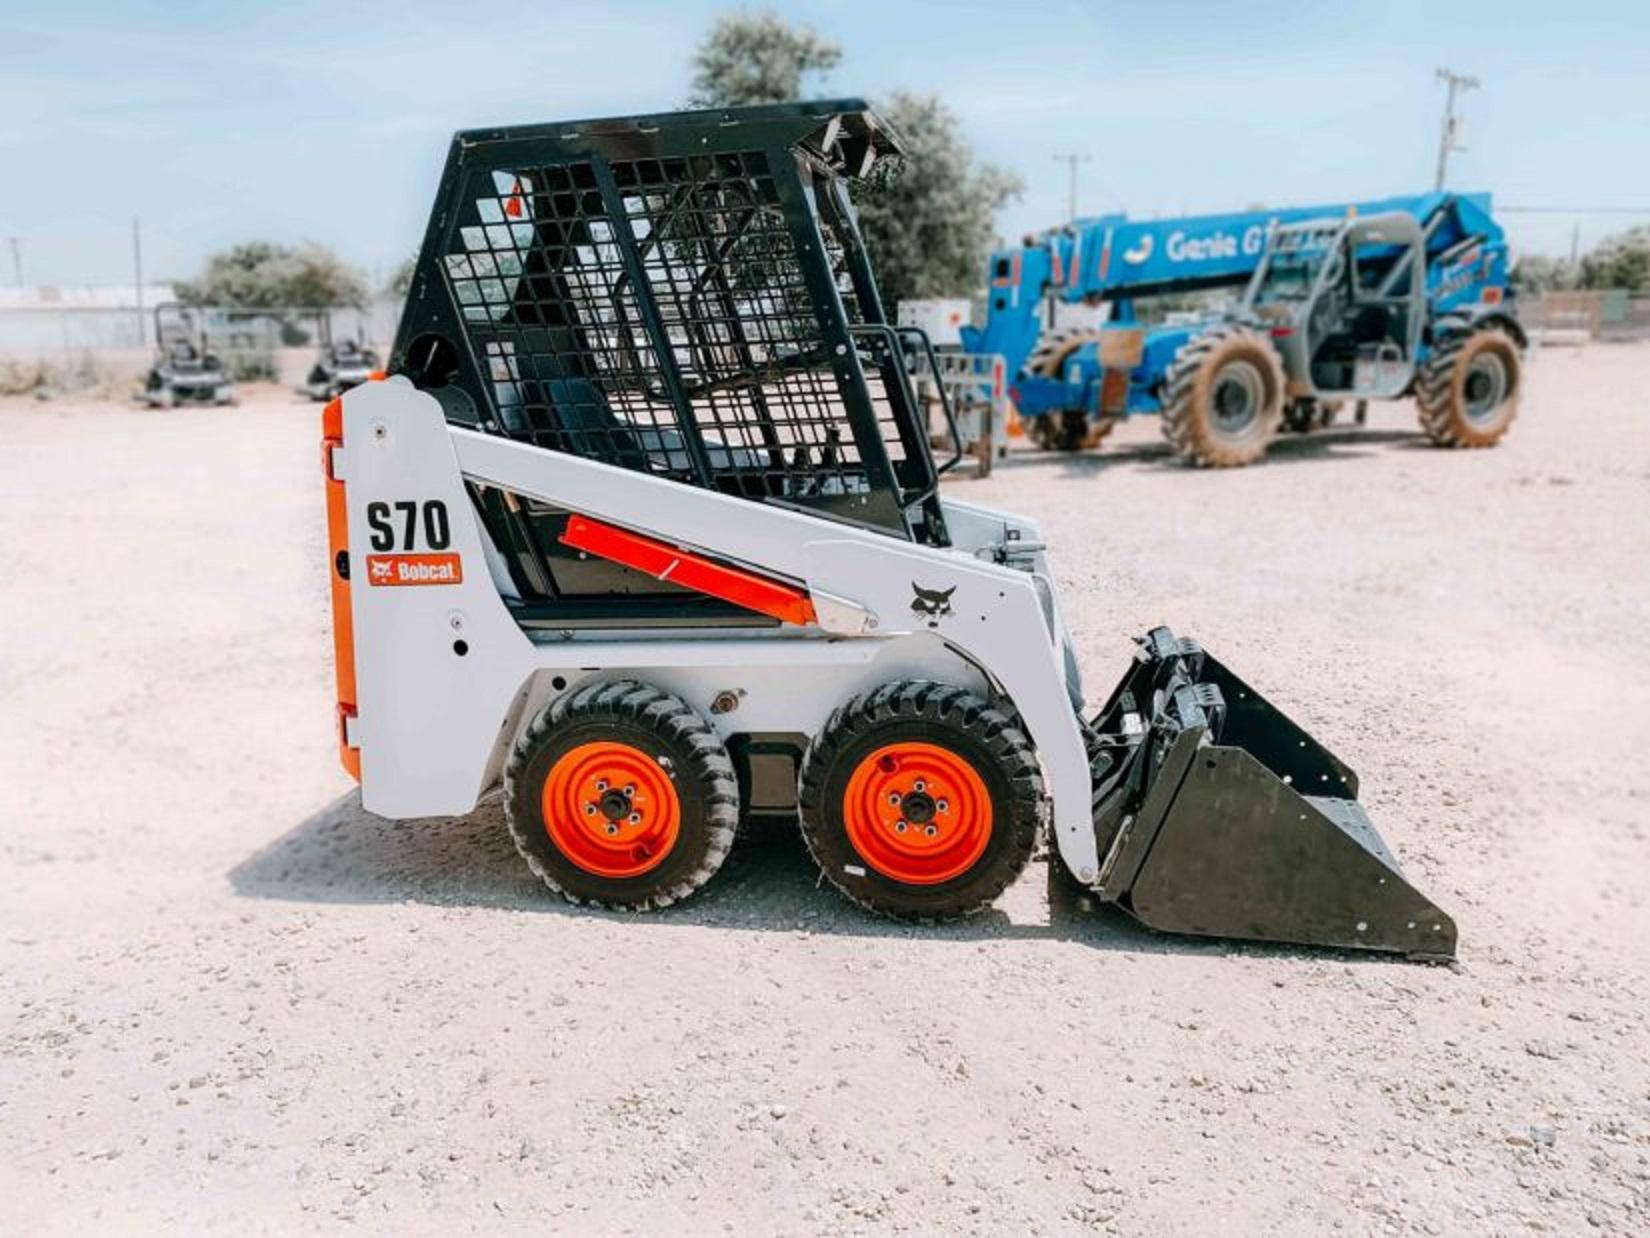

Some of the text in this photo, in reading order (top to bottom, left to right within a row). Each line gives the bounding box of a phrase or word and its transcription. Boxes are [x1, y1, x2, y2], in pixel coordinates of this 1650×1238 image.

[1166, 230, 1237, 262] Genie
[367, 499, 451, 552] S70
[397, 561, 455, 581] Bobcat
